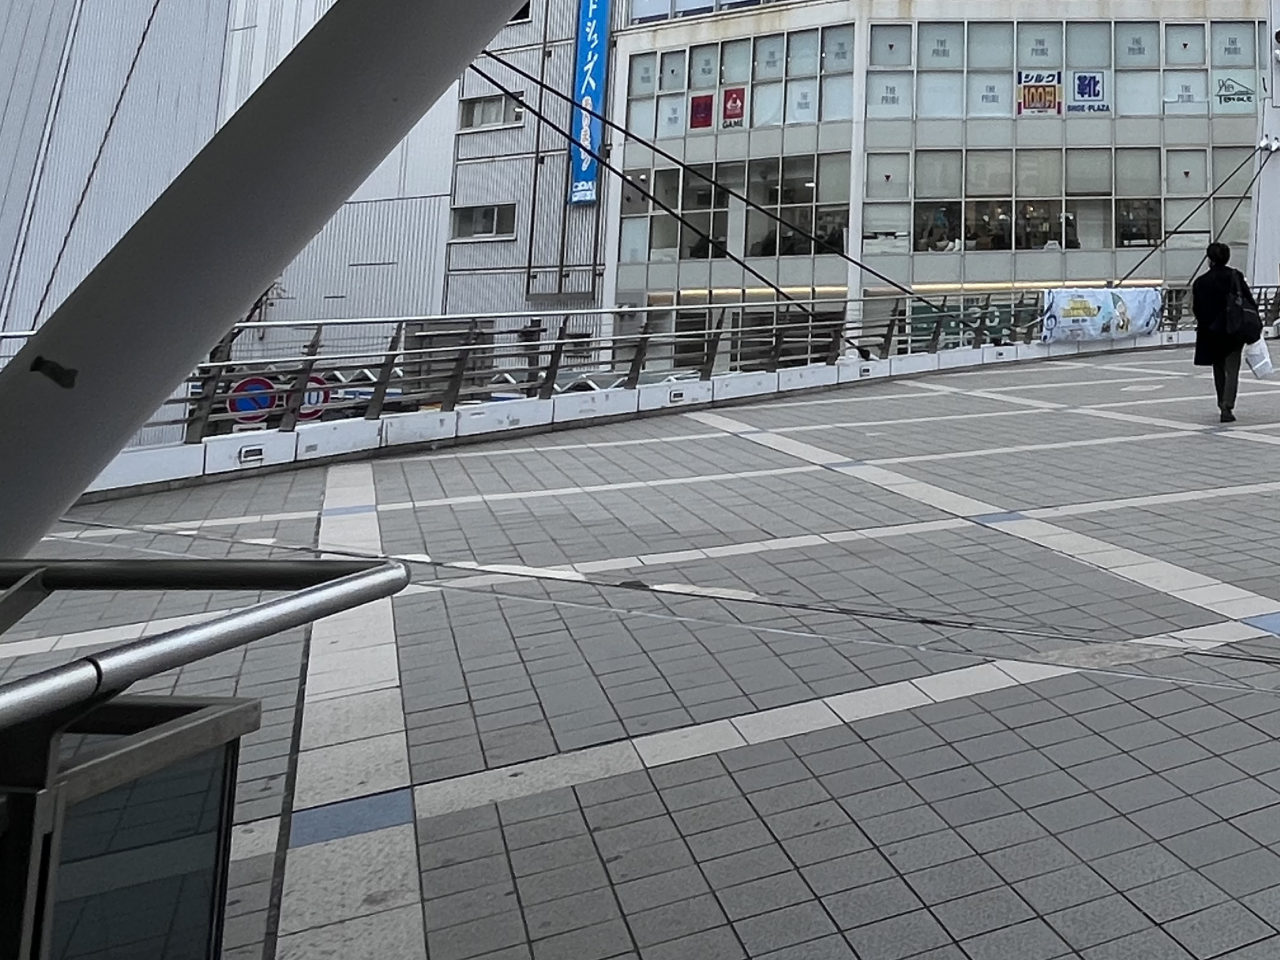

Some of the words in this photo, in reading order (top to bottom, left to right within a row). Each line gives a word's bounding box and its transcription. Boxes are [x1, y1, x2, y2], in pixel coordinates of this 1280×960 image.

[1023, 74, 1056, 83] シルク
[1077, 74, 1100, 98] 靴
[1024, 87, 1055, 108] 100円
[722, 119, 743, 129] GAME
